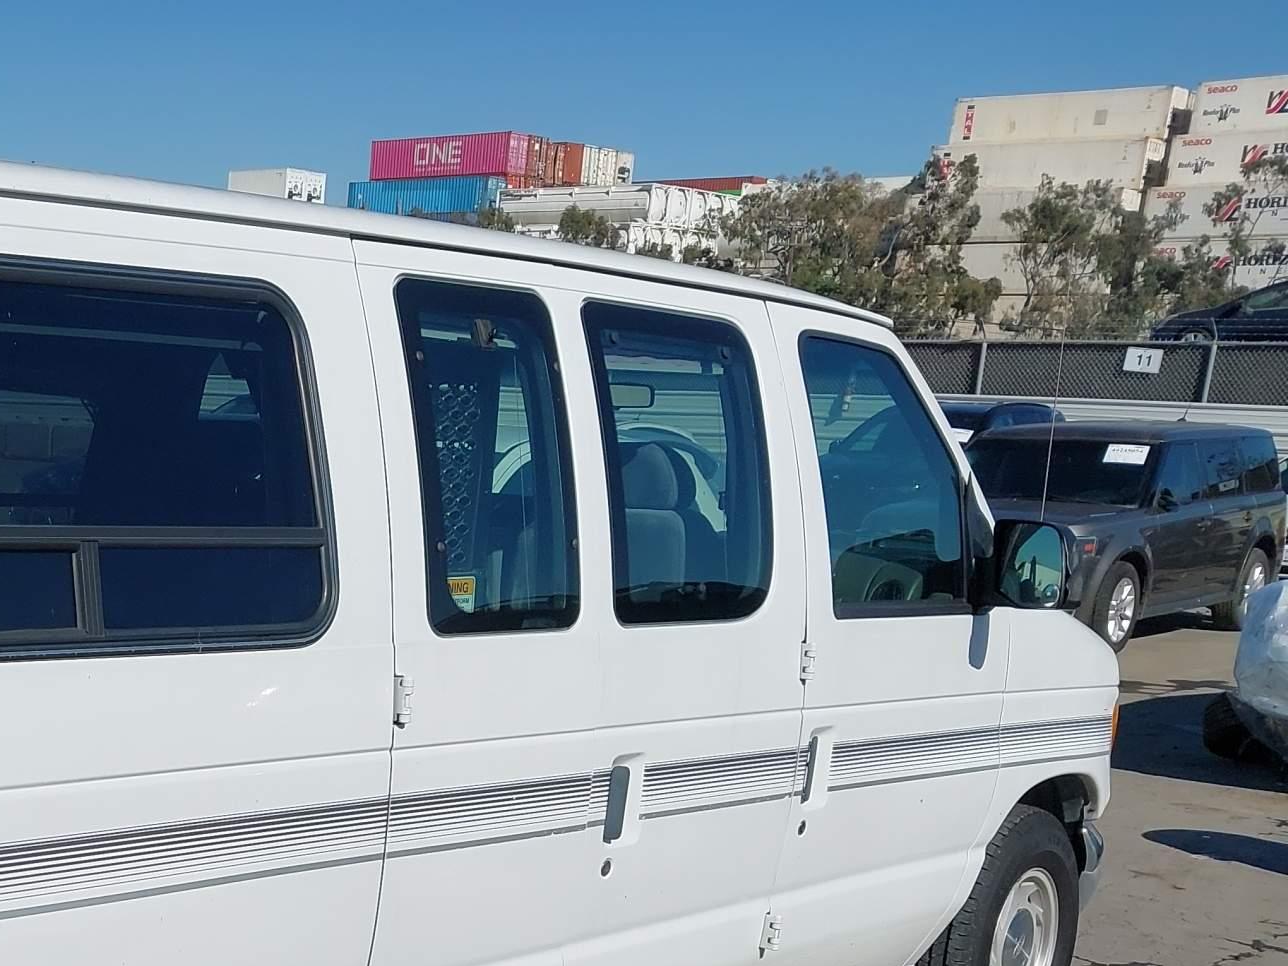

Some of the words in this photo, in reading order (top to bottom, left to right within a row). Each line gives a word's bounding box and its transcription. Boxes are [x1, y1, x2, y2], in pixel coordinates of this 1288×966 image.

[1207, 85, 1238, 94] seaco
[1182, 138, 1212, 147] seaco
[413, 141, 462, 166] ONE
[1156, 191, 1186, 199] seaco
[1137, 354, 1152, 367] 11
